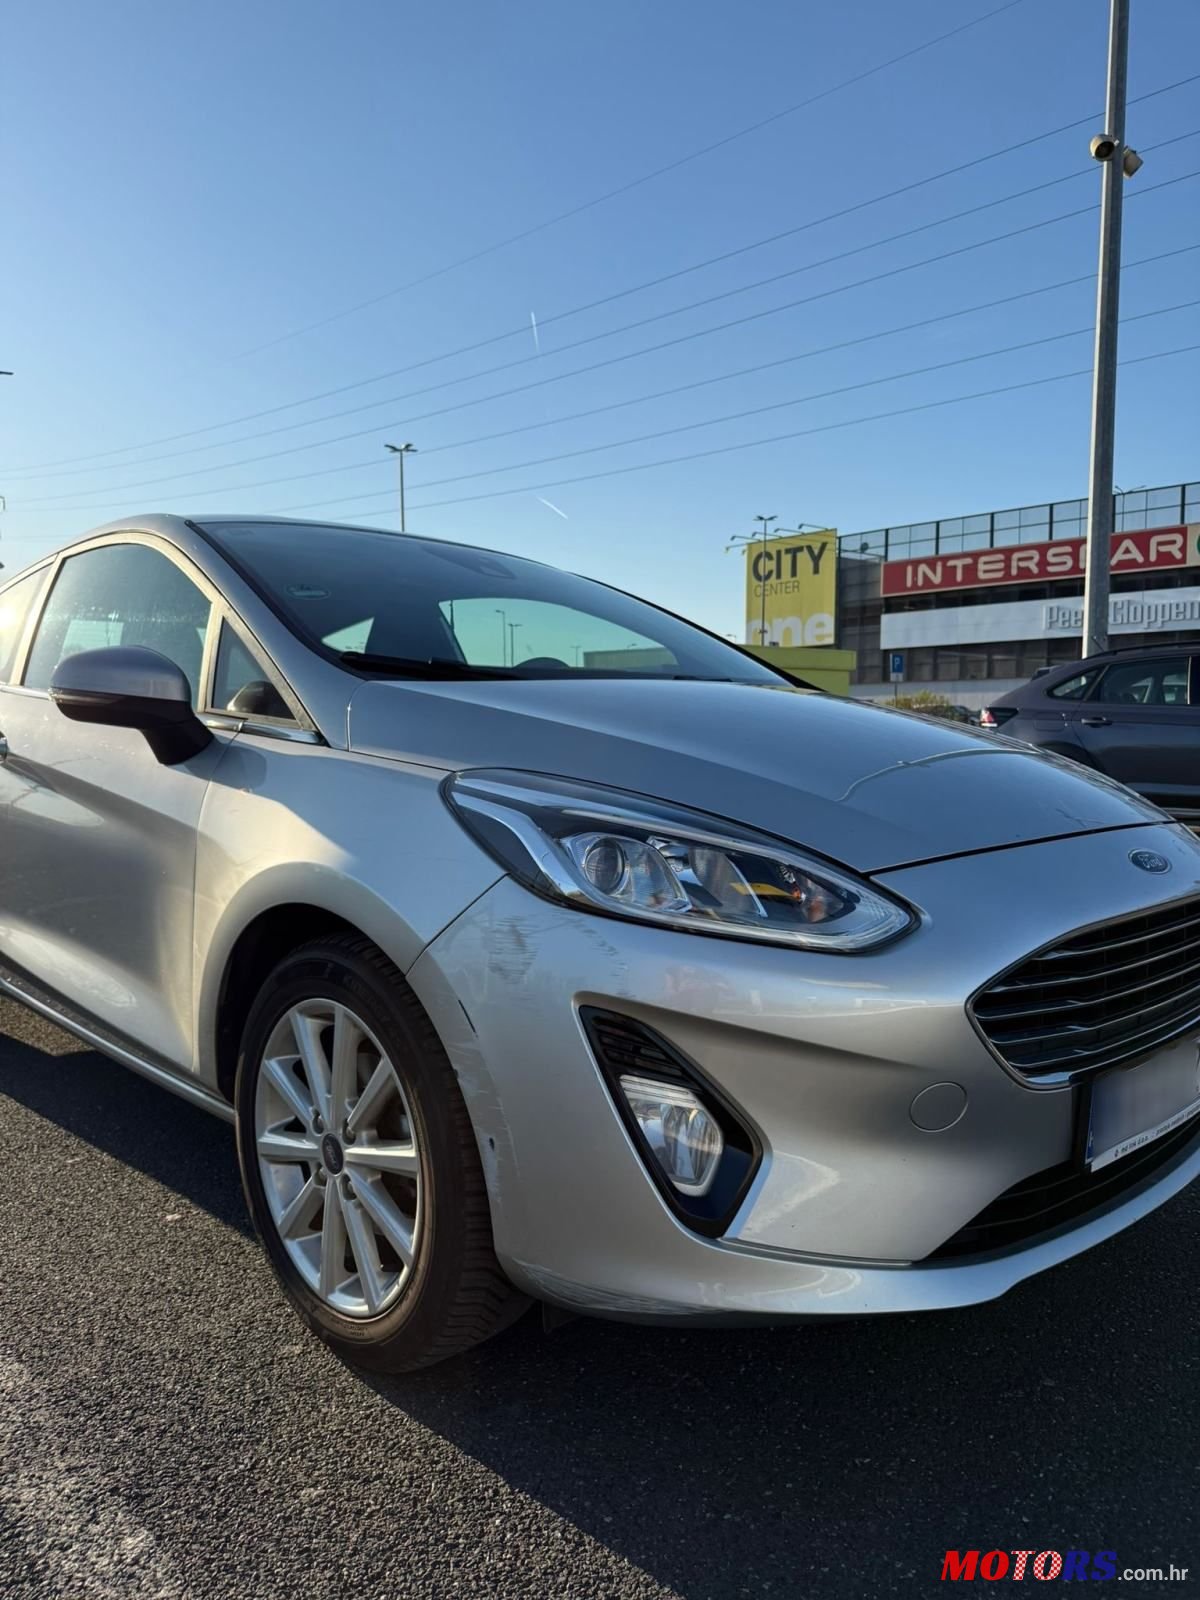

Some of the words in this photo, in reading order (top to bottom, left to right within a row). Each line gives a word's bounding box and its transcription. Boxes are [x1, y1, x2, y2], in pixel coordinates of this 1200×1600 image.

[752, 541, 828, 583] CITY
[906, 532, 1184, 588] INTERSAR
[753, 580, 800, 598] CENTER
[1043, 604, 1084, 630] Pee
[894, 656, 901, 669] P
